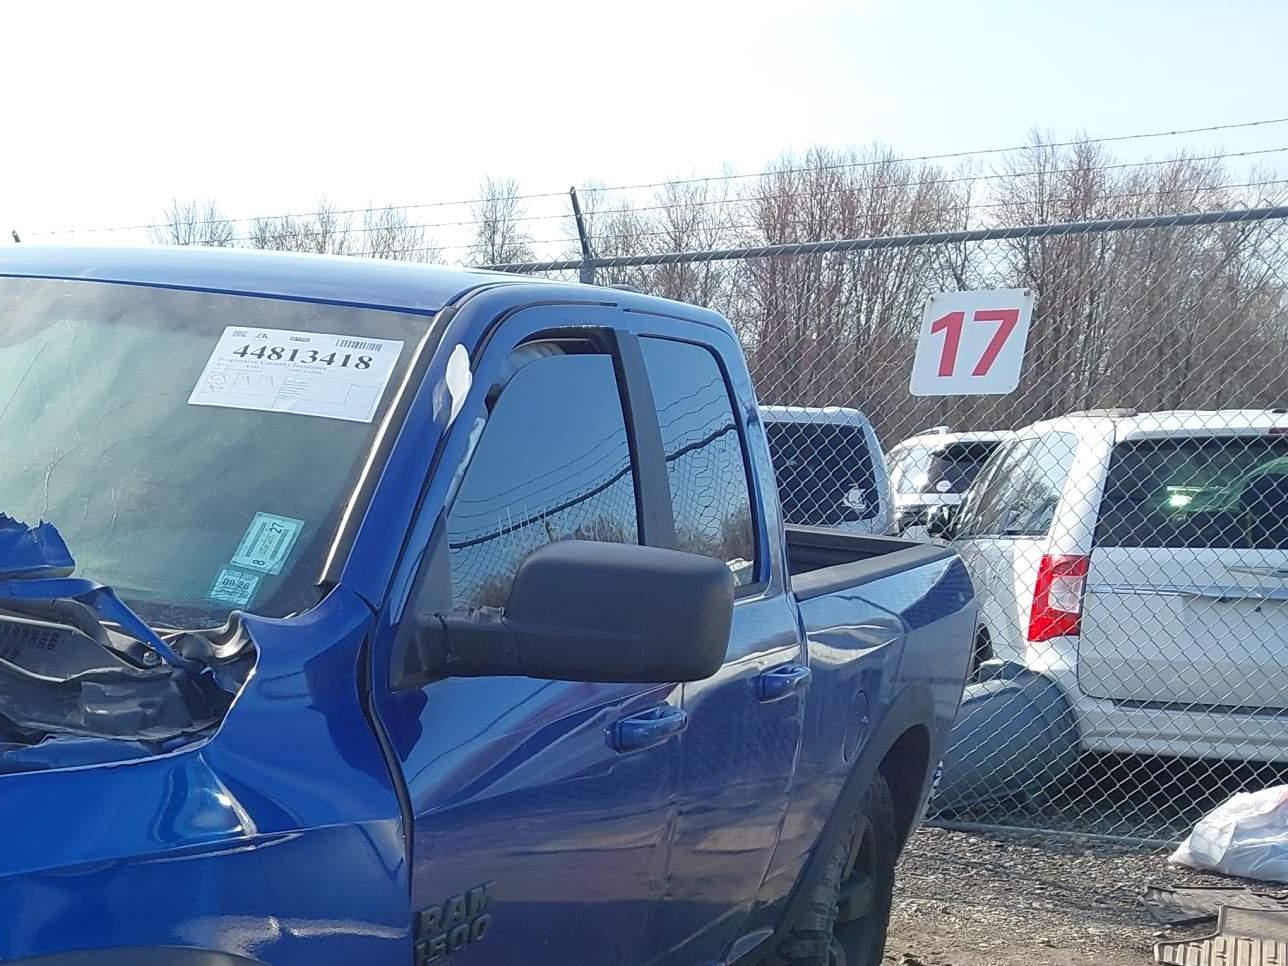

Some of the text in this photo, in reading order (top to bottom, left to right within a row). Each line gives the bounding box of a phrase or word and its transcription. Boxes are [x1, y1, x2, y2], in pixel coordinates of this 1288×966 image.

[232, 343, 374, 370] 44813418
[930, 308, 1020, 377] 17
[269, 521, 284, 534] 27
[413, 879, 496, 945] RAM
